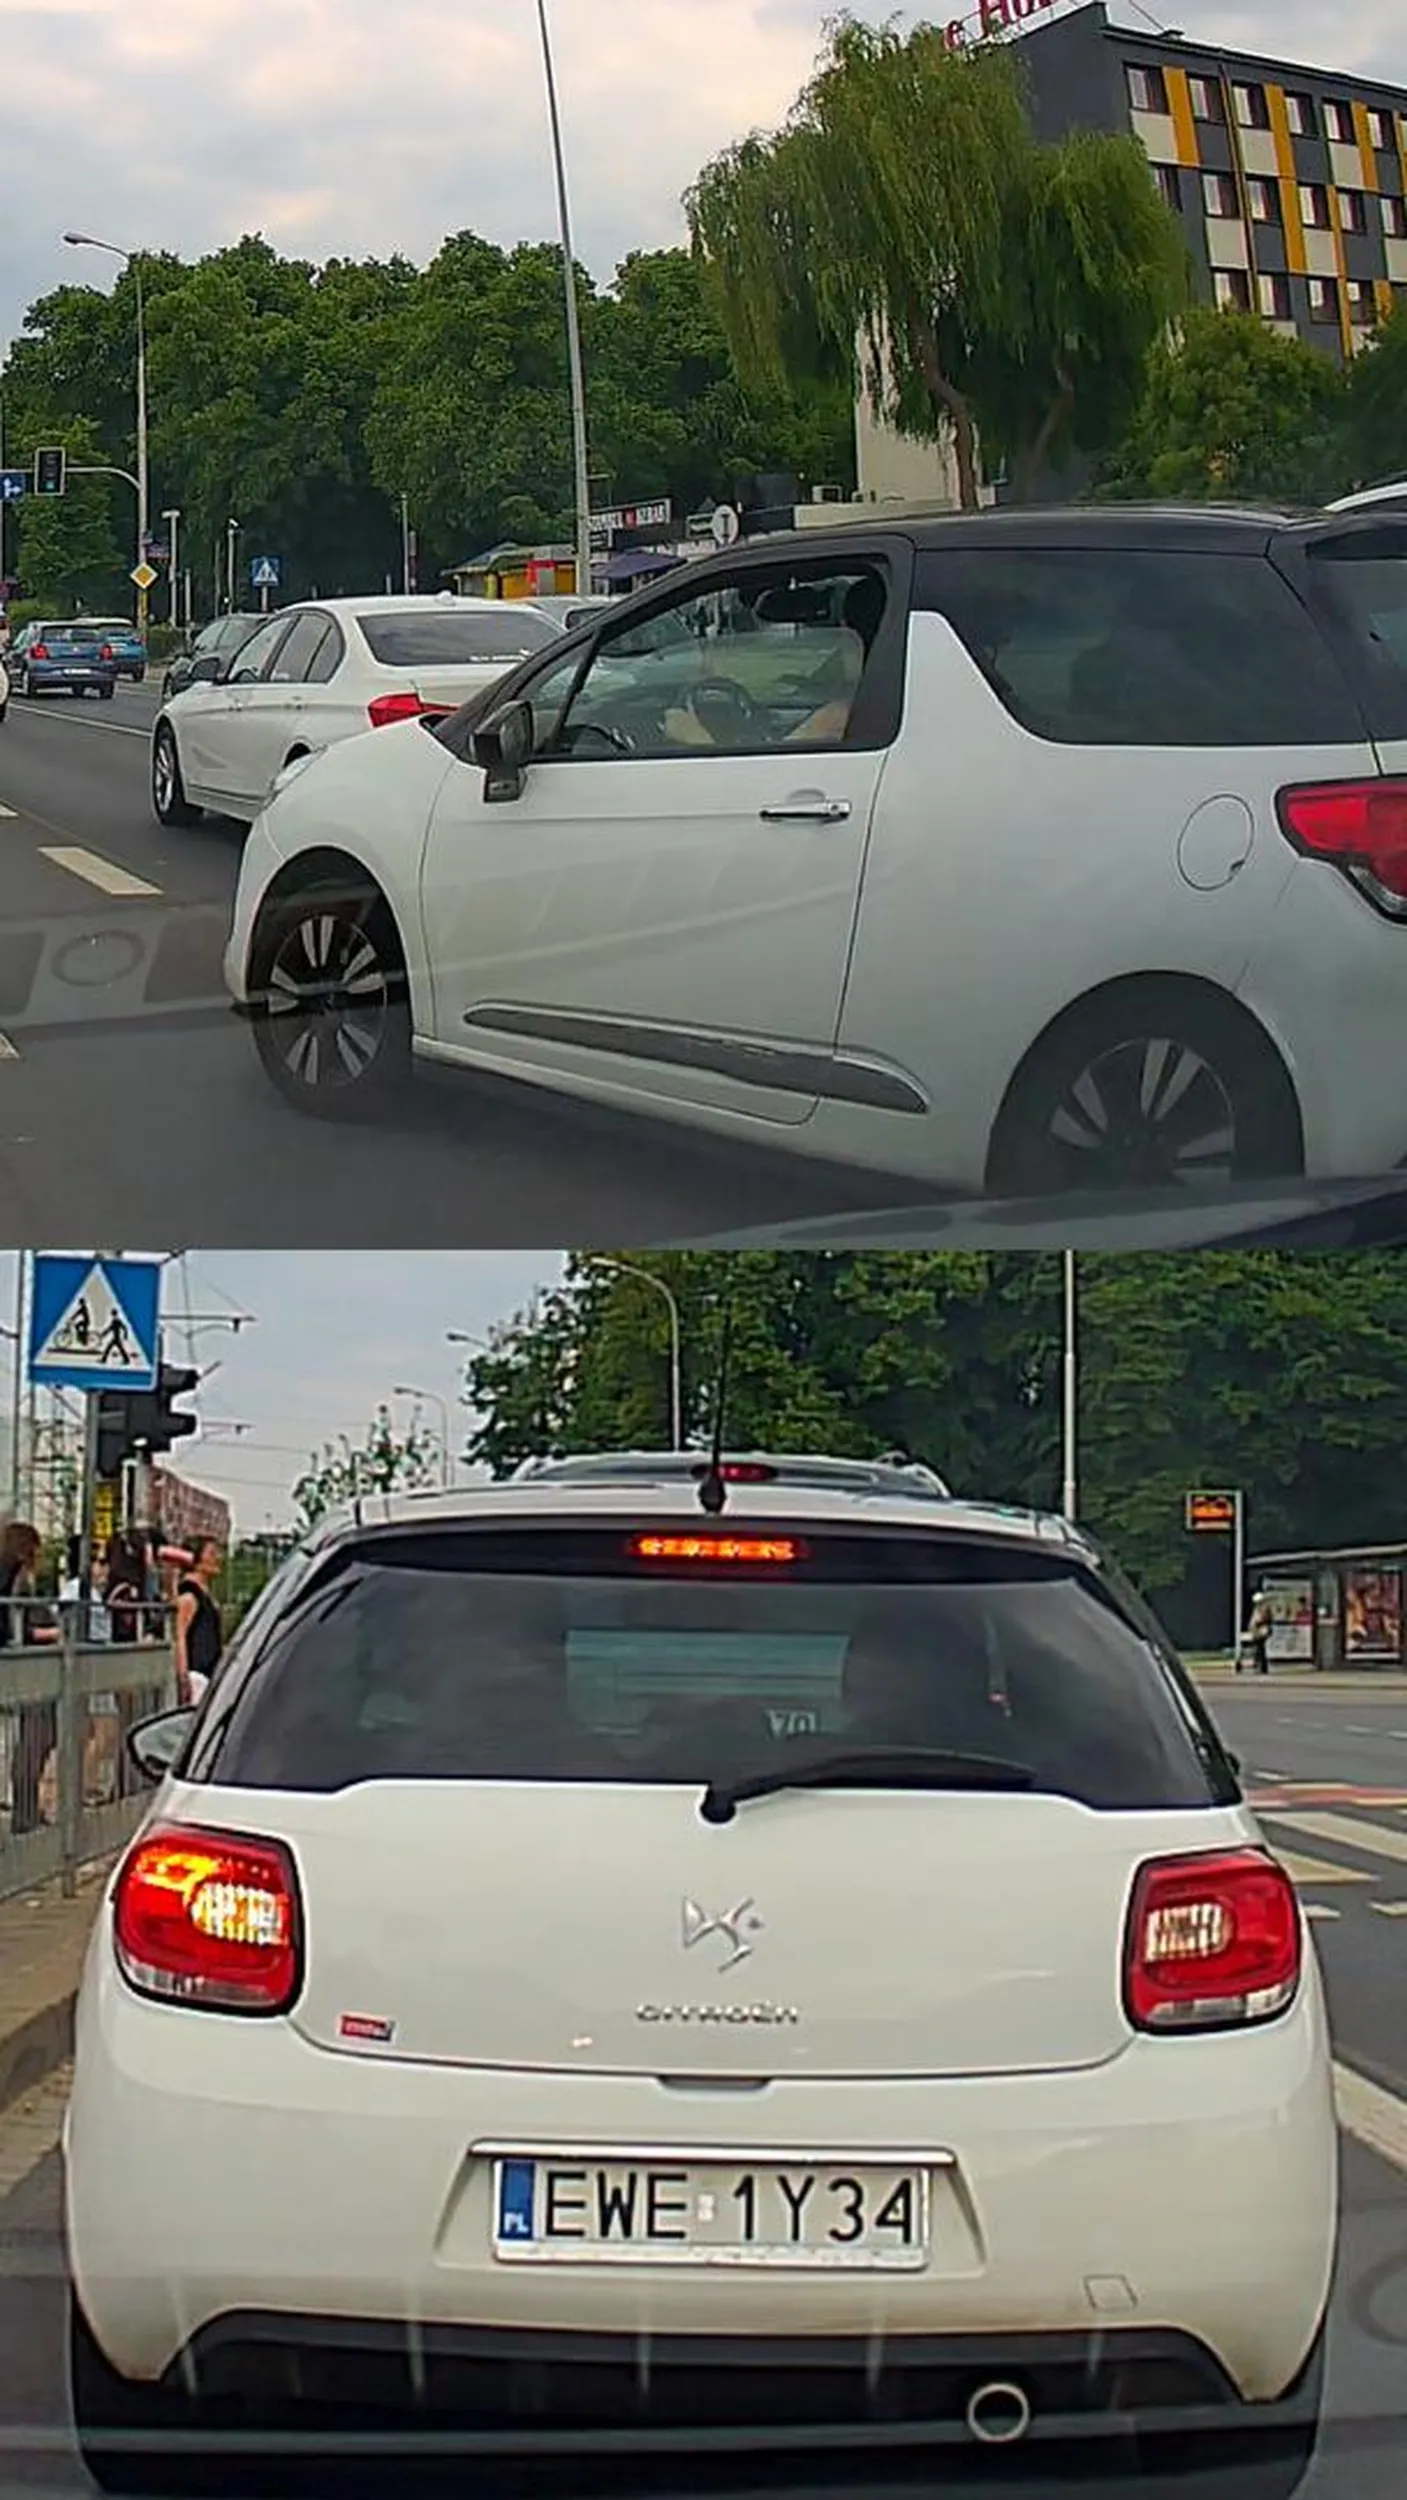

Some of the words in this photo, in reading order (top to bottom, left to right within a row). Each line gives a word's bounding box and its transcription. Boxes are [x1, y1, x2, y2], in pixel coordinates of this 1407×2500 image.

[504, 2211, 530, 2234] PL
[546, 2171, 688, 2239] EWE
[733, 2174, 913, 2244] 1Y34
